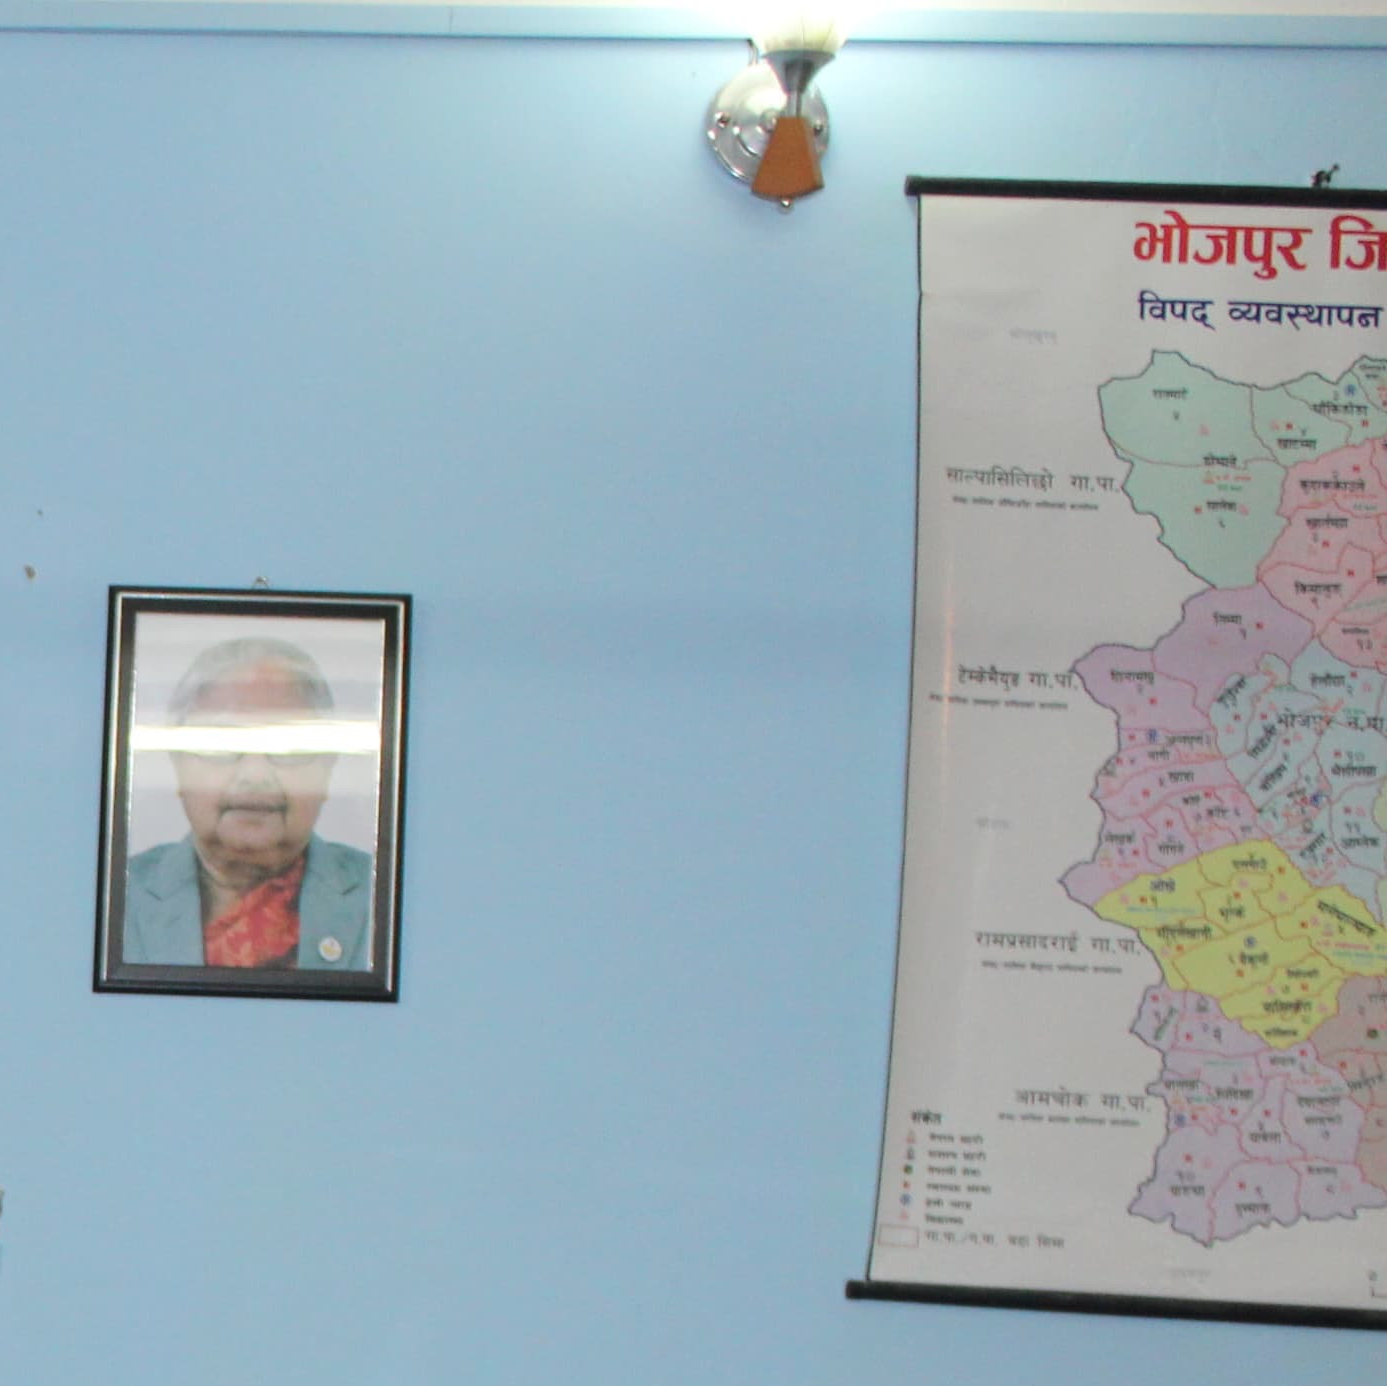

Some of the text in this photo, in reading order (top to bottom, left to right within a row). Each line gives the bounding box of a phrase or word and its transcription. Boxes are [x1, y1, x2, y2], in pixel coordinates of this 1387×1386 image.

[1134, 210, 1313, 280] भोजपुर
[1138, 289, 1385, 331] विपद् व्यवस्थापन
